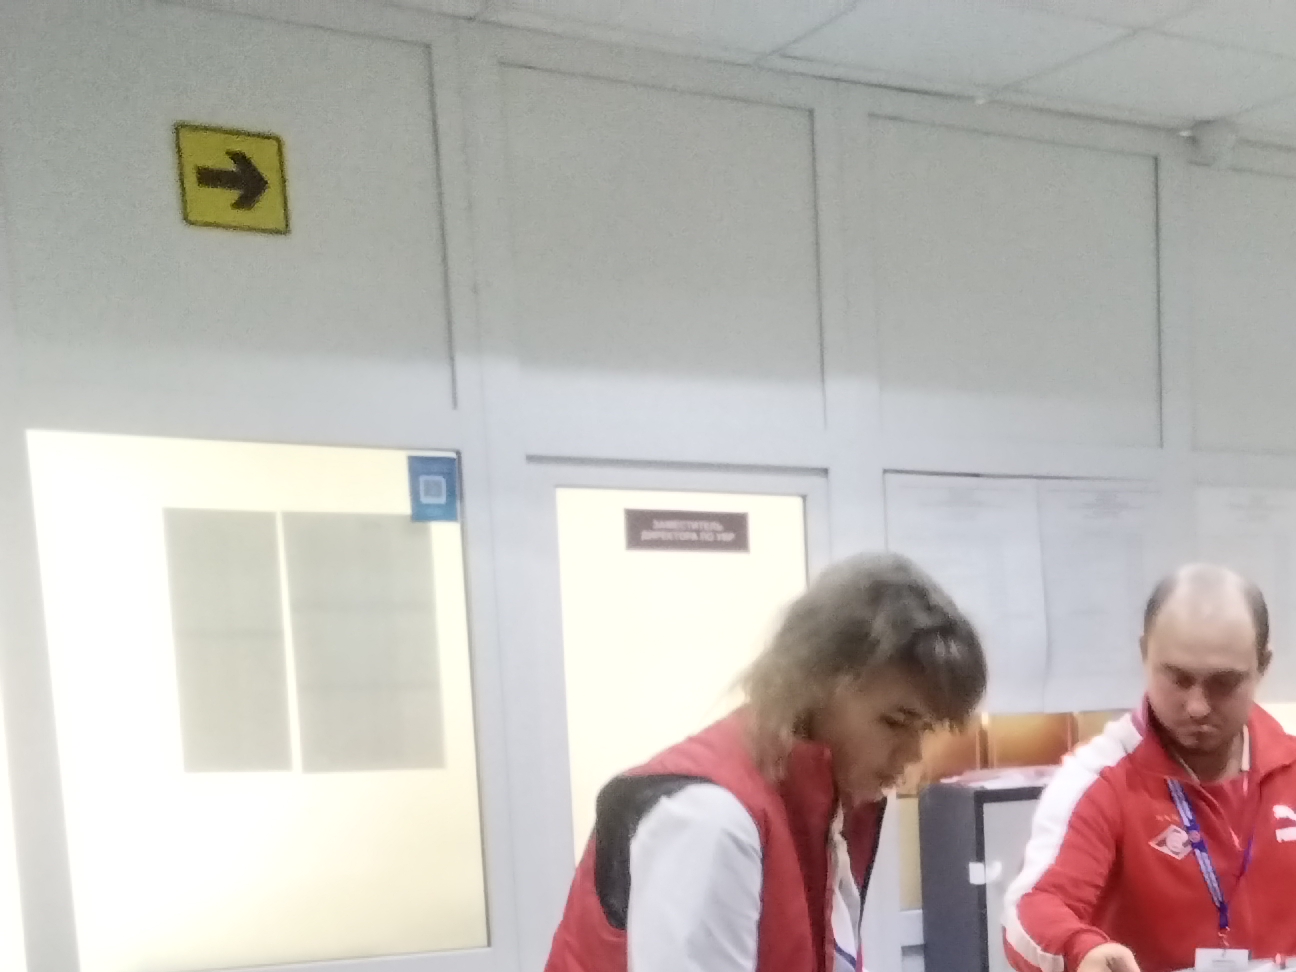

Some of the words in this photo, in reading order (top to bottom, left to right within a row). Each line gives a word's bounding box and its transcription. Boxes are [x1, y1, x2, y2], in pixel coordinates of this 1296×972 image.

[652, 519, 724, 531] ЗАМЕСТИТЕЛЬ
[641, 530, 698, 541] ДИРЕКТОРА
[700, 531, 714, 541] ПО
